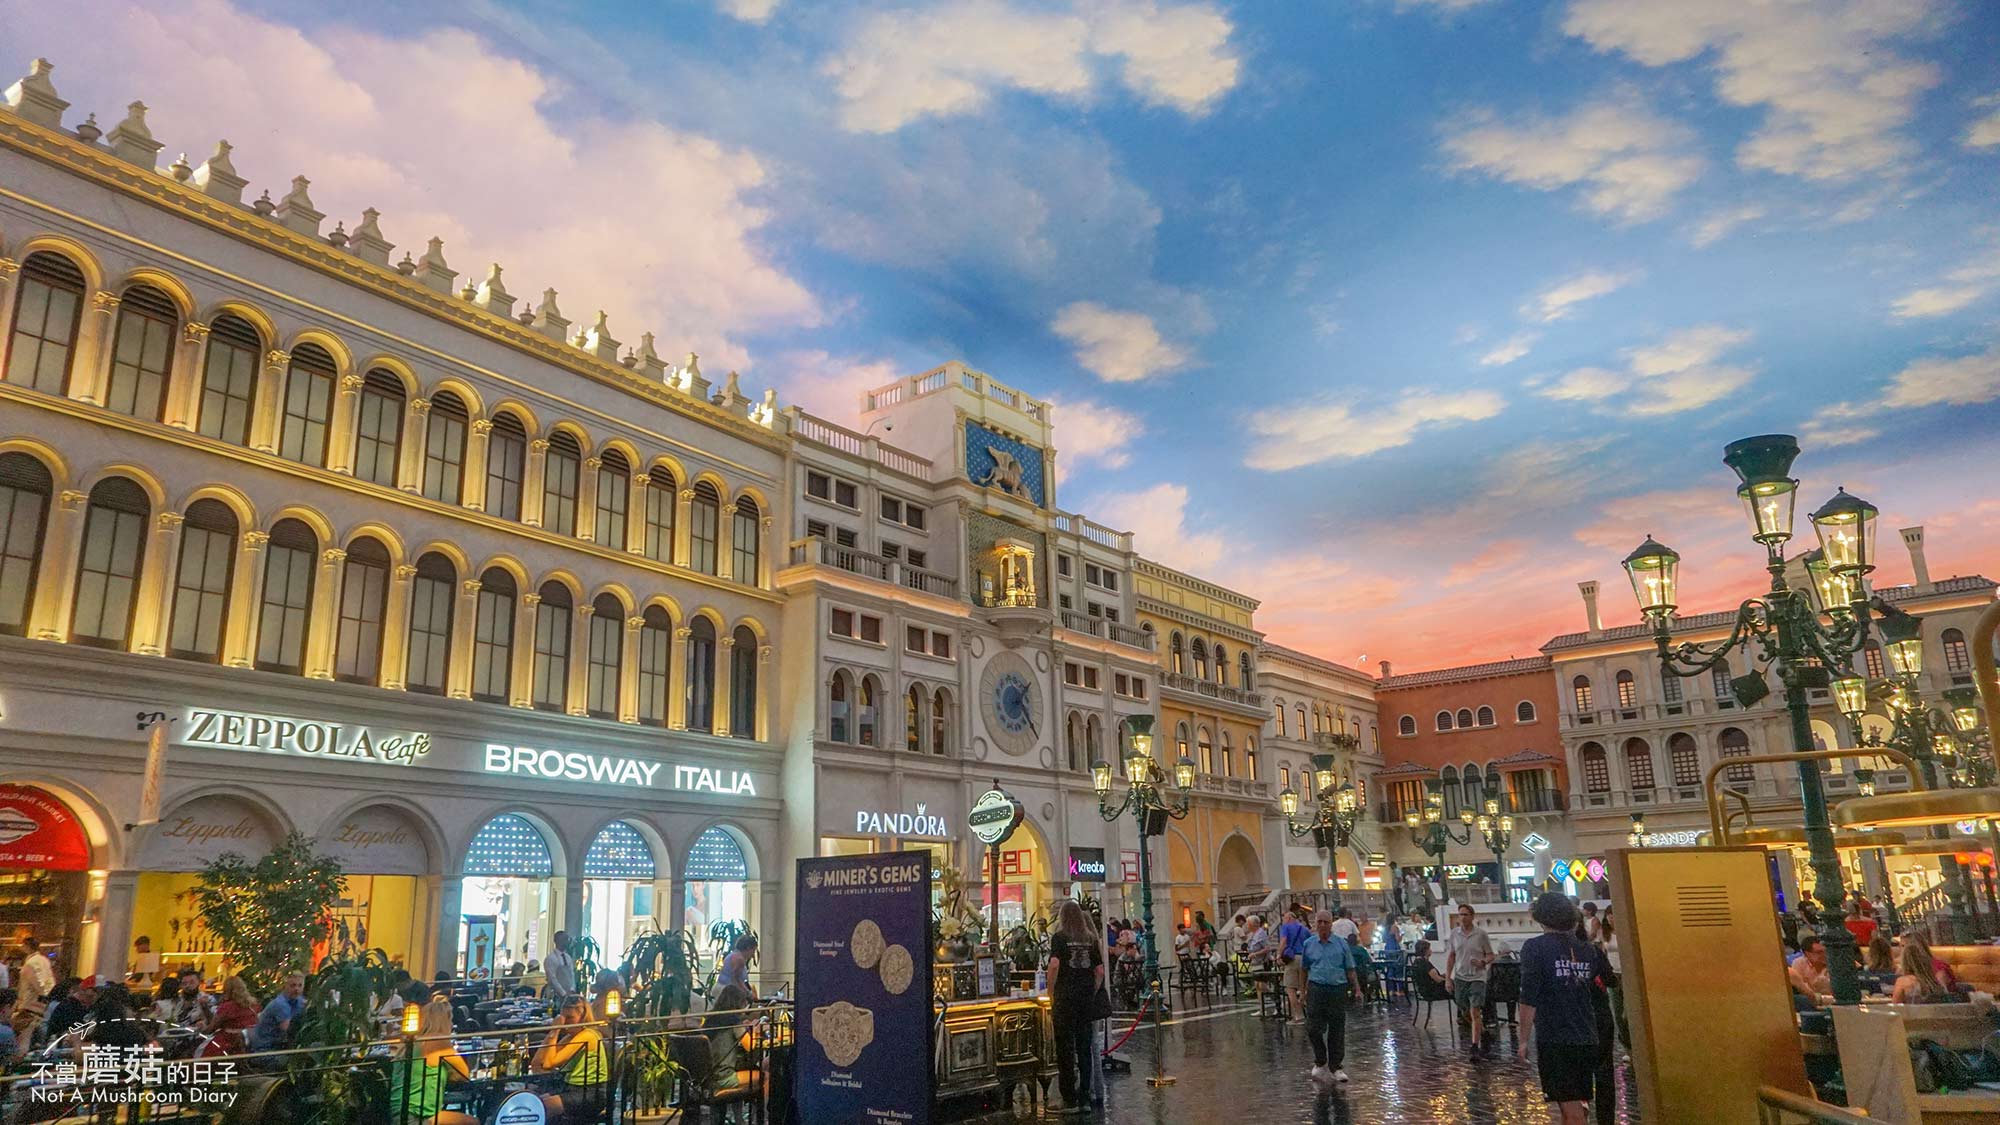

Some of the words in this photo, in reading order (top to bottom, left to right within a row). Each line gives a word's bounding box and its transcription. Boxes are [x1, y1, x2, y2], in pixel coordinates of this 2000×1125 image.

[187, 711, 376, 758] ZEPPOLA
[380, 733, 431, 764] Café
[484, 743, 661, 786] BROSWAY
[675, 765, 756, 795] ITALIA
[36, 801, 66, 823] MARKET
[856, 810, 947, 836] PANDORA
[162, 816, 254, 844] Zeppola
[333, 823, 408, 848] Zeppola
[823, 865, 878, 887] MINER'S
[881, 864, 920, 884] GEMS
[844, 887, 867, 895] JEWELRY
[874, 886, 895, 894] EXOTIC
